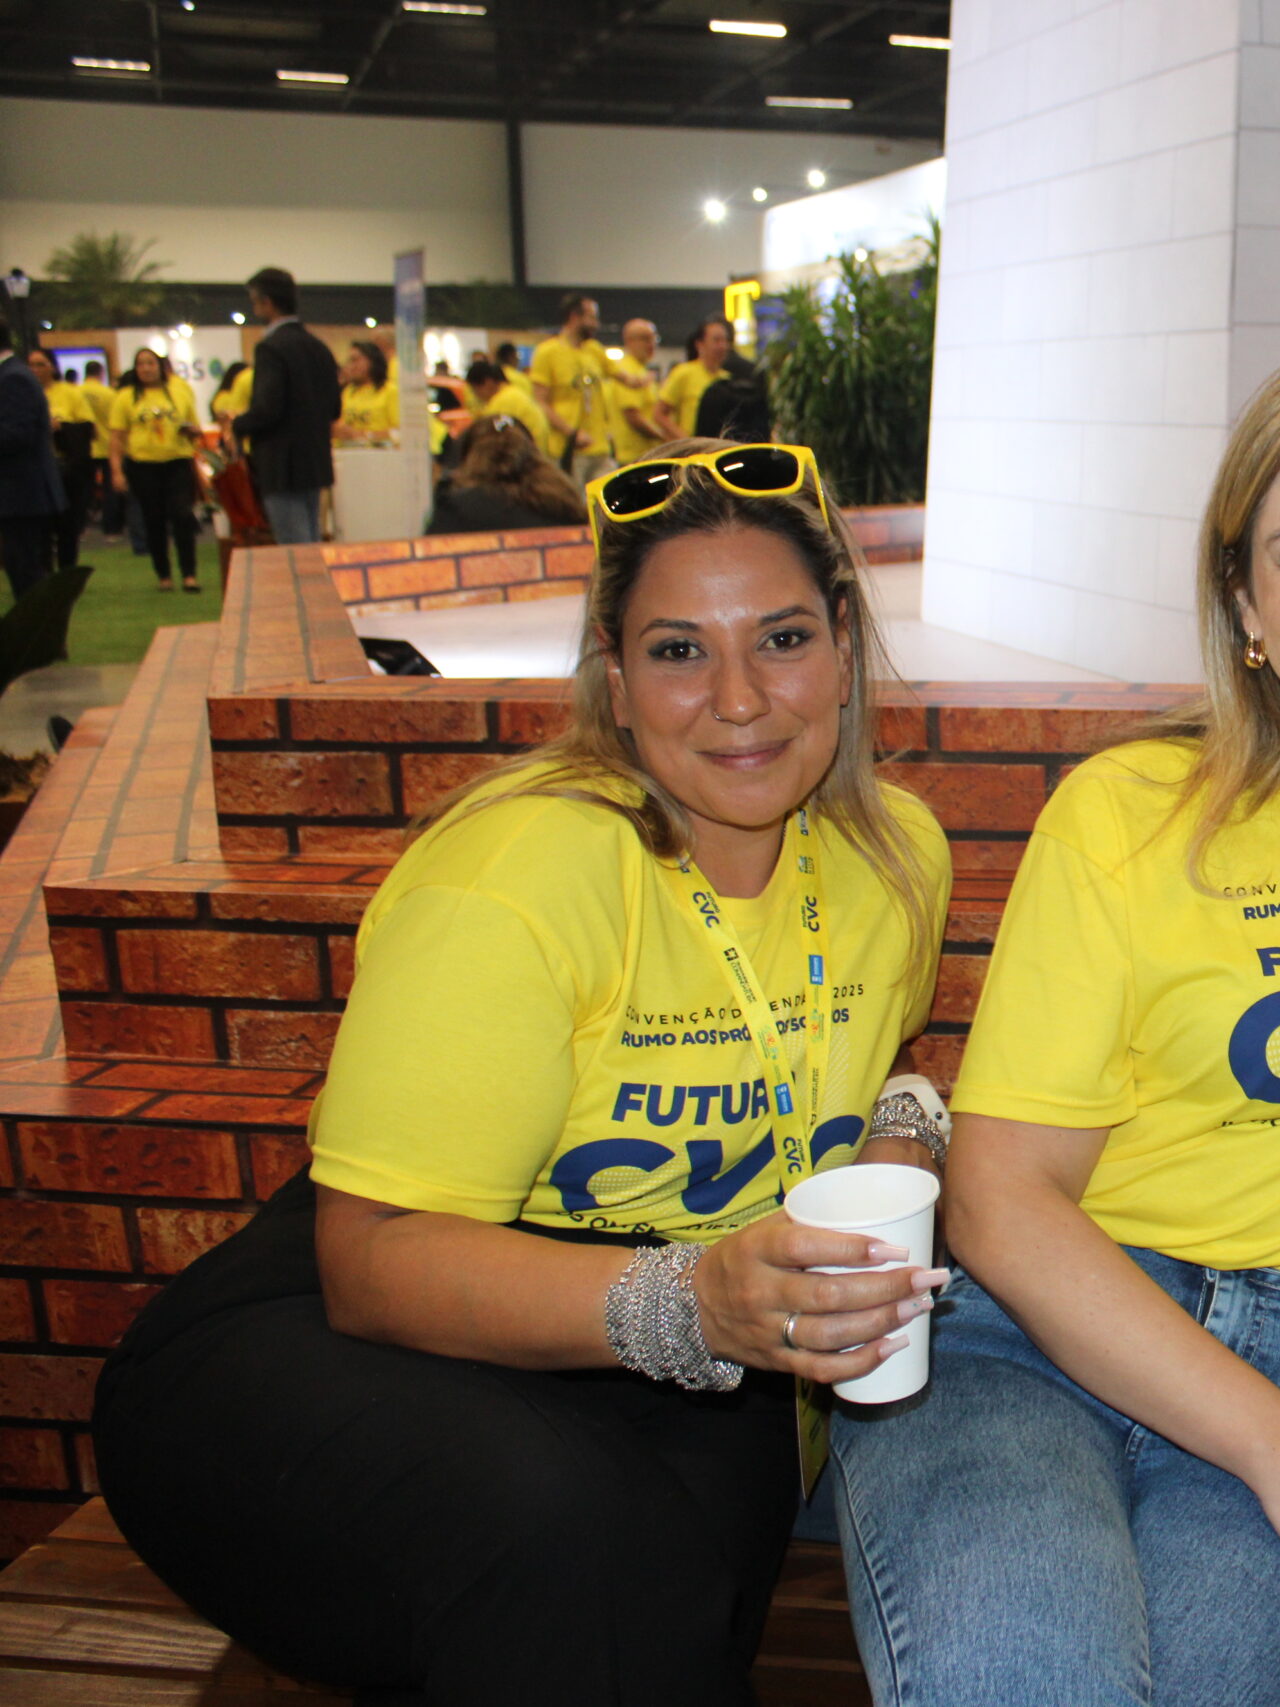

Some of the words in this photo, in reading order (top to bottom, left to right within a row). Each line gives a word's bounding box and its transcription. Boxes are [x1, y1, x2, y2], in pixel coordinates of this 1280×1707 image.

[693, 892, 720, 928] CVC
[805, 896, 820, 932] CVC
[833, 984, 864, 998] 2025
[621, 1031, 676, 1047] RUMO
[682, 1029, 717, 1046] AOS
[611, 1070, 796, 1126] FUTUR
[783, 1137, 802, 1174] CVC
